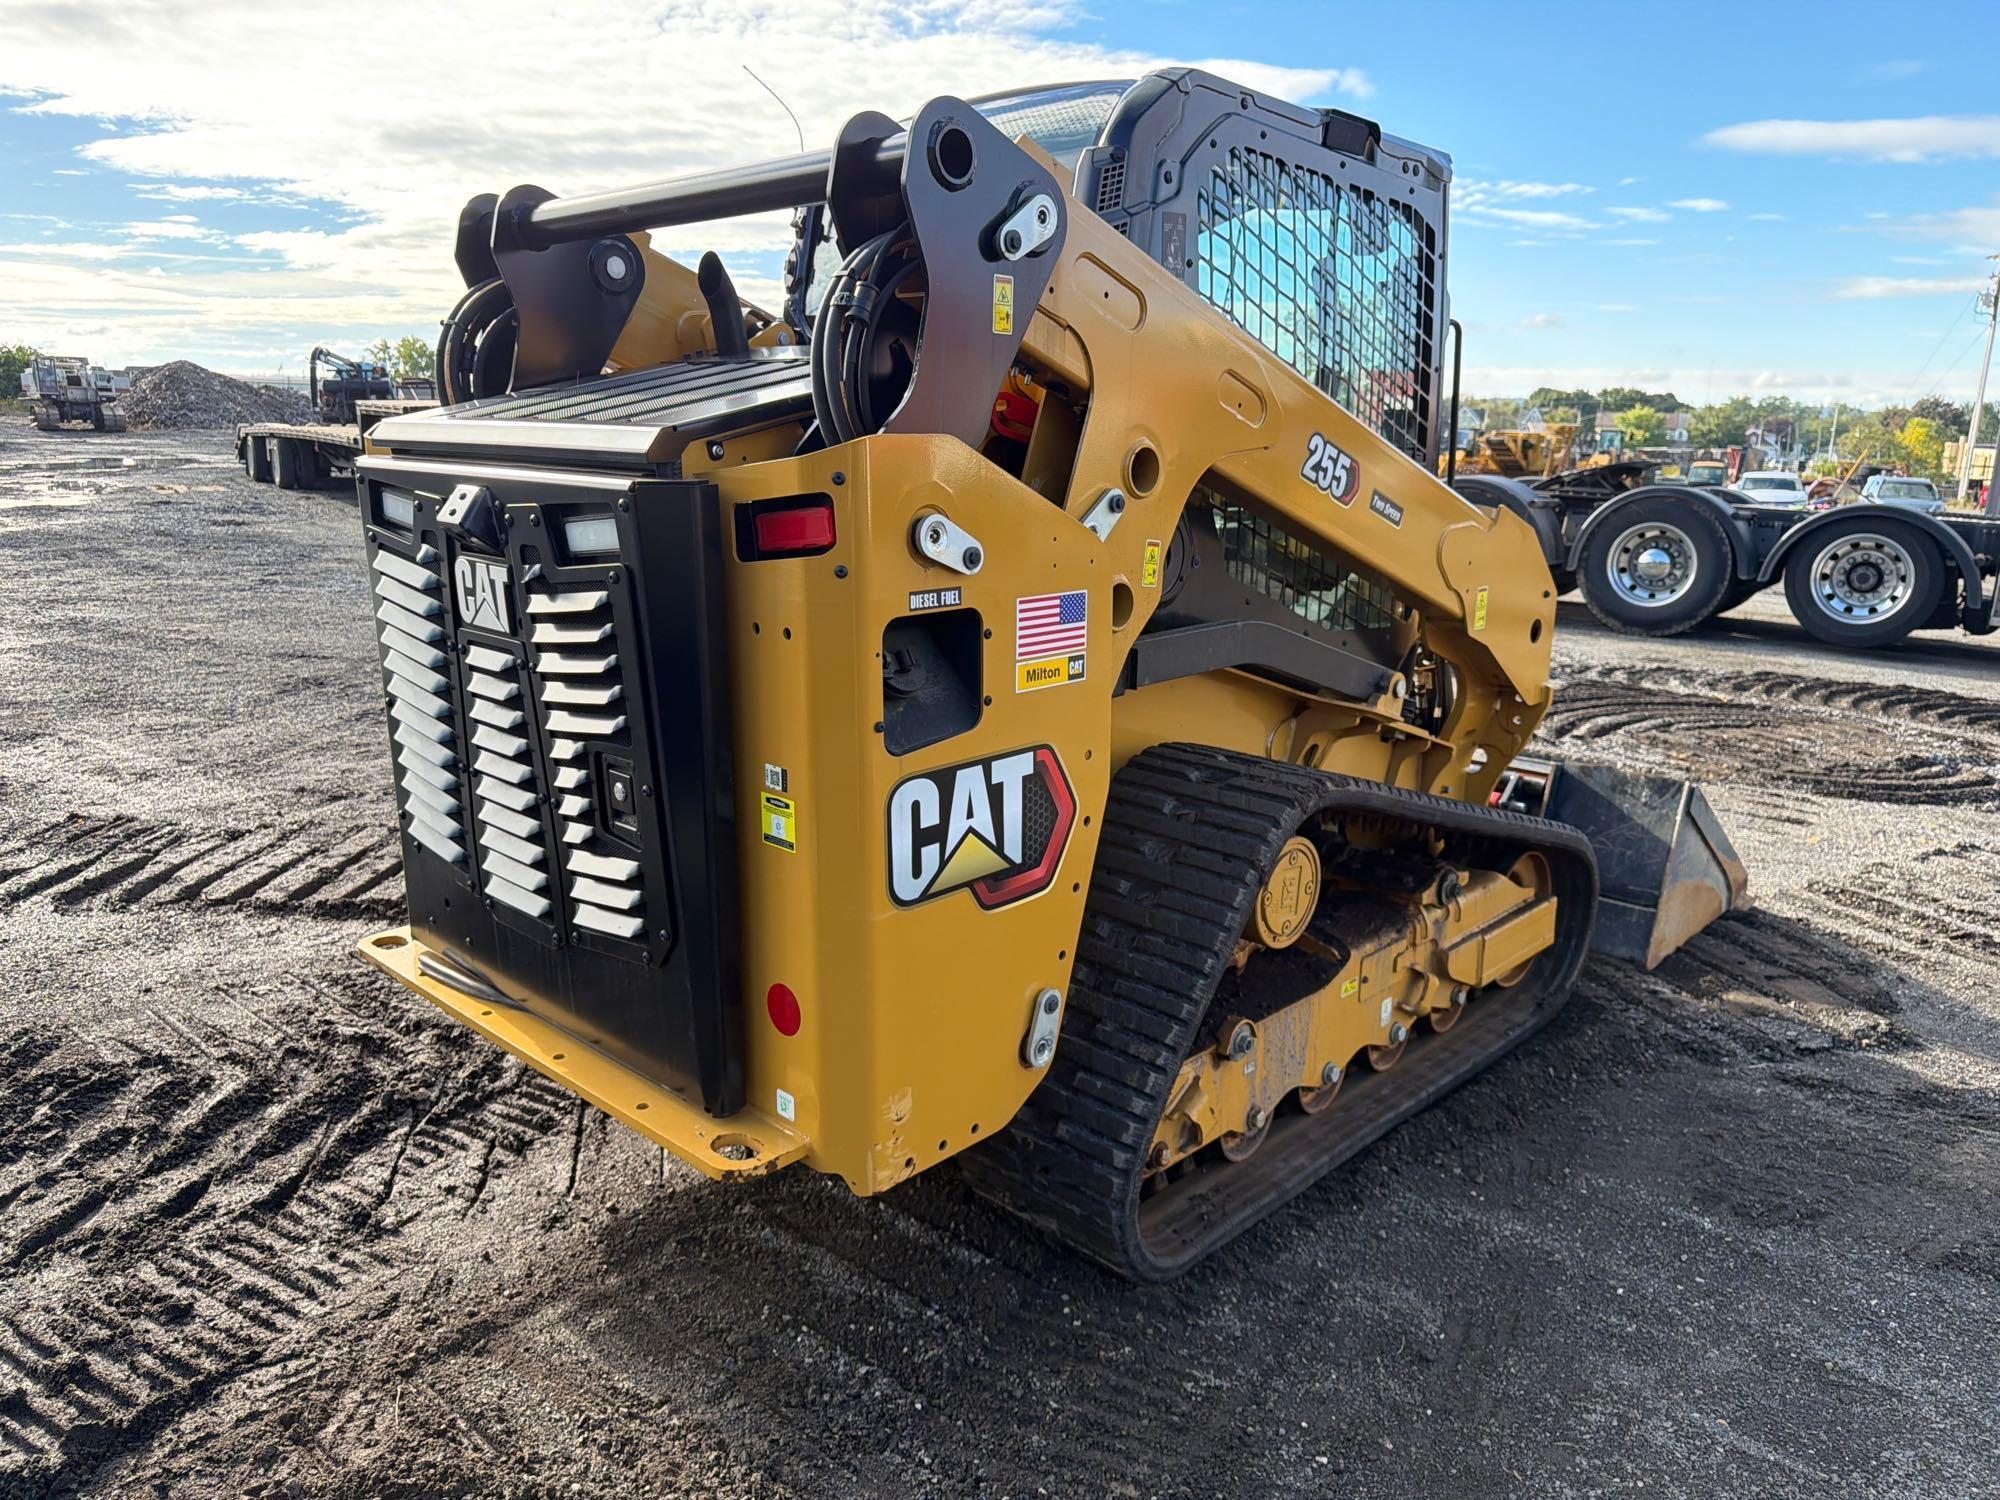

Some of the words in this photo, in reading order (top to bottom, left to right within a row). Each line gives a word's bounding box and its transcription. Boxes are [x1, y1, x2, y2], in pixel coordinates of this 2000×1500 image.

[1302, 434, 1352, 497] 255
[455, 558, 510, 633] CAT
[910, 592, 939, 609] DIESEL
[941, 590, 961, 606] FUEL
[1026, 667, 1060, 682] Milton
[1069, 659, 1084, 675] CAT
[891, 751, 1034, 900] CAT
